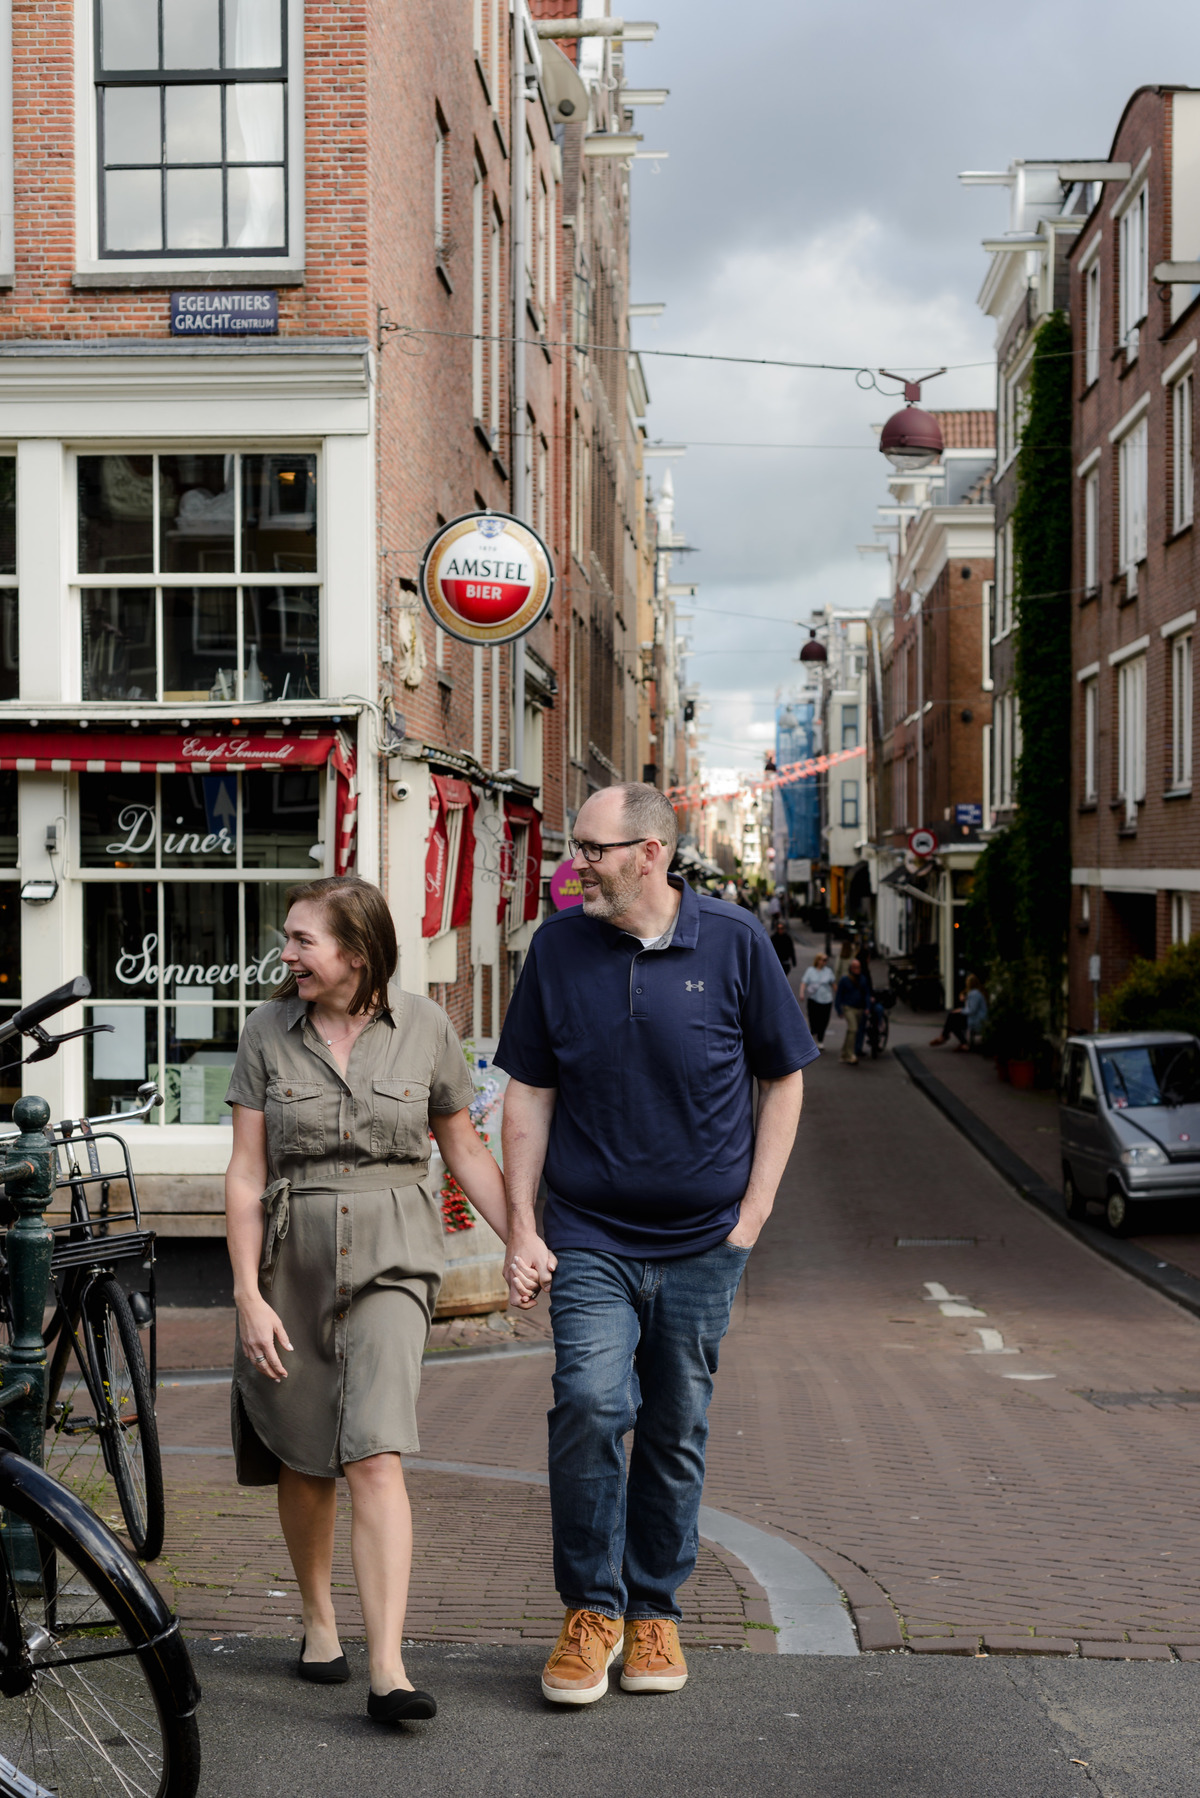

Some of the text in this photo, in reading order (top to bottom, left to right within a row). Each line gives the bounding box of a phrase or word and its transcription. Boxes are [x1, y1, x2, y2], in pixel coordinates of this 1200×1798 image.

[178, 295, 271, 312] EGELANTIERS
[174, 313, 275, 330] GRACHT CENTRUM
[446, 558, 527, 581] AMSTEL
[465, 583, 503, 601] BIER
[224, 739, 295, 759] Sonneveld
[105, 803, 233, 854] Diner
